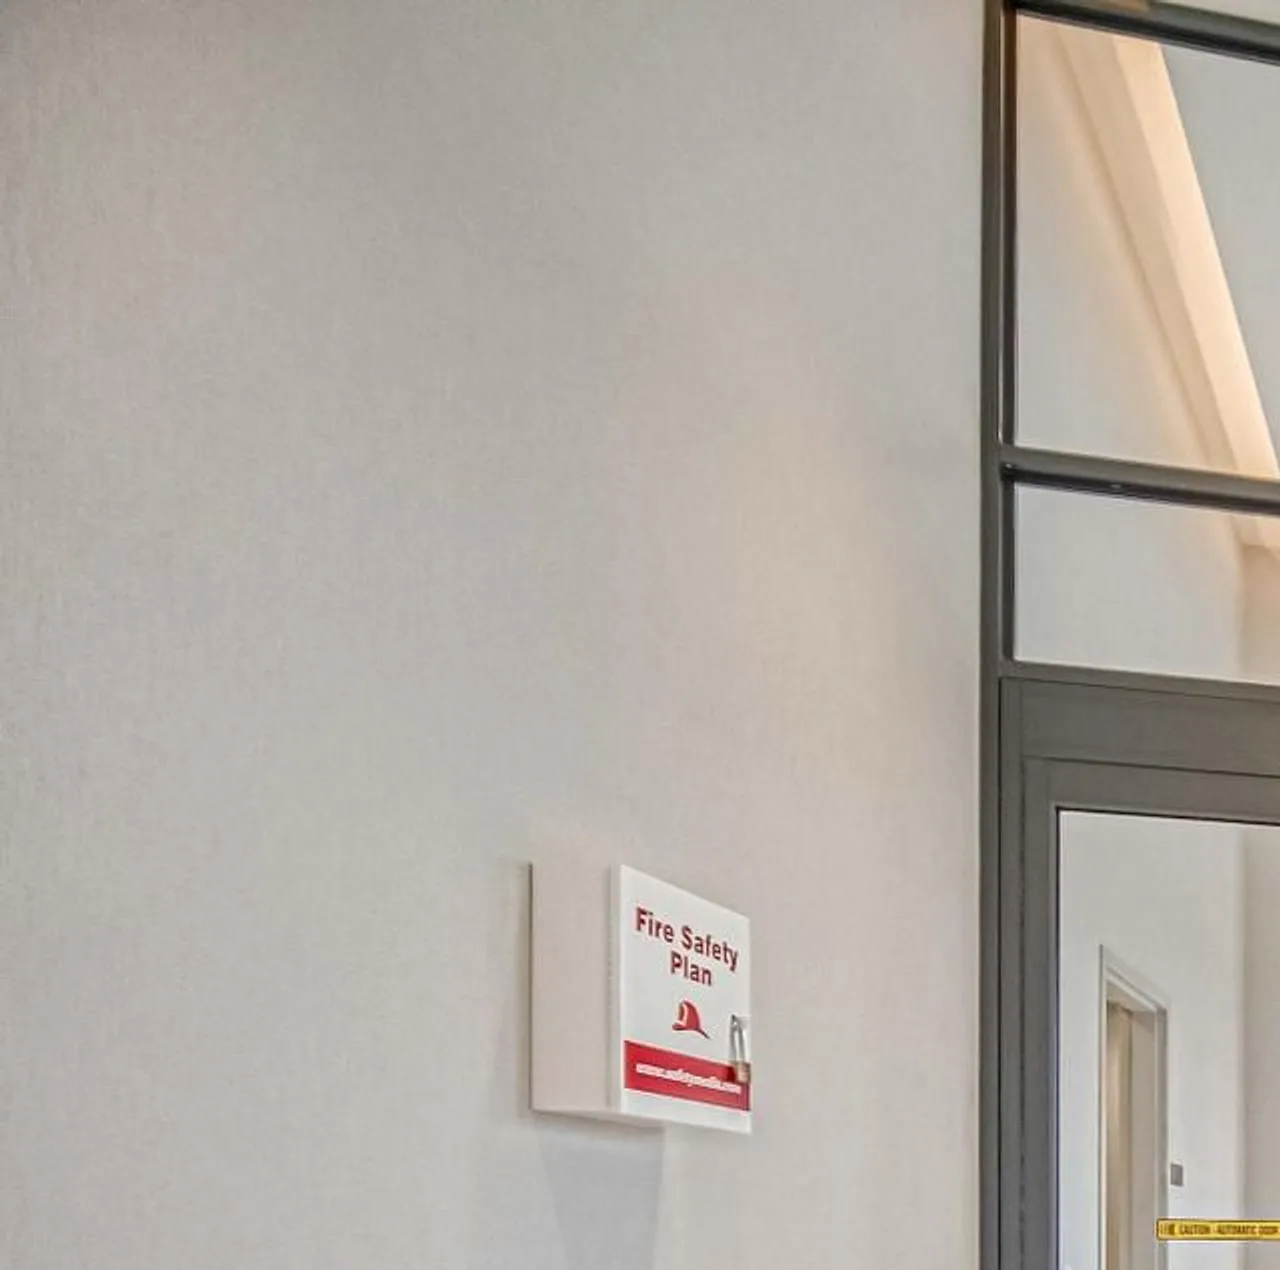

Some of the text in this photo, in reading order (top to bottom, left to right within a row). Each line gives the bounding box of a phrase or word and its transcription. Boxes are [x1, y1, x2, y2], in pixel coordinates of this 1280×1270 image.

[635, 905, 738, 972] Fire Safety
[671, 950, 712, 986] Plan
